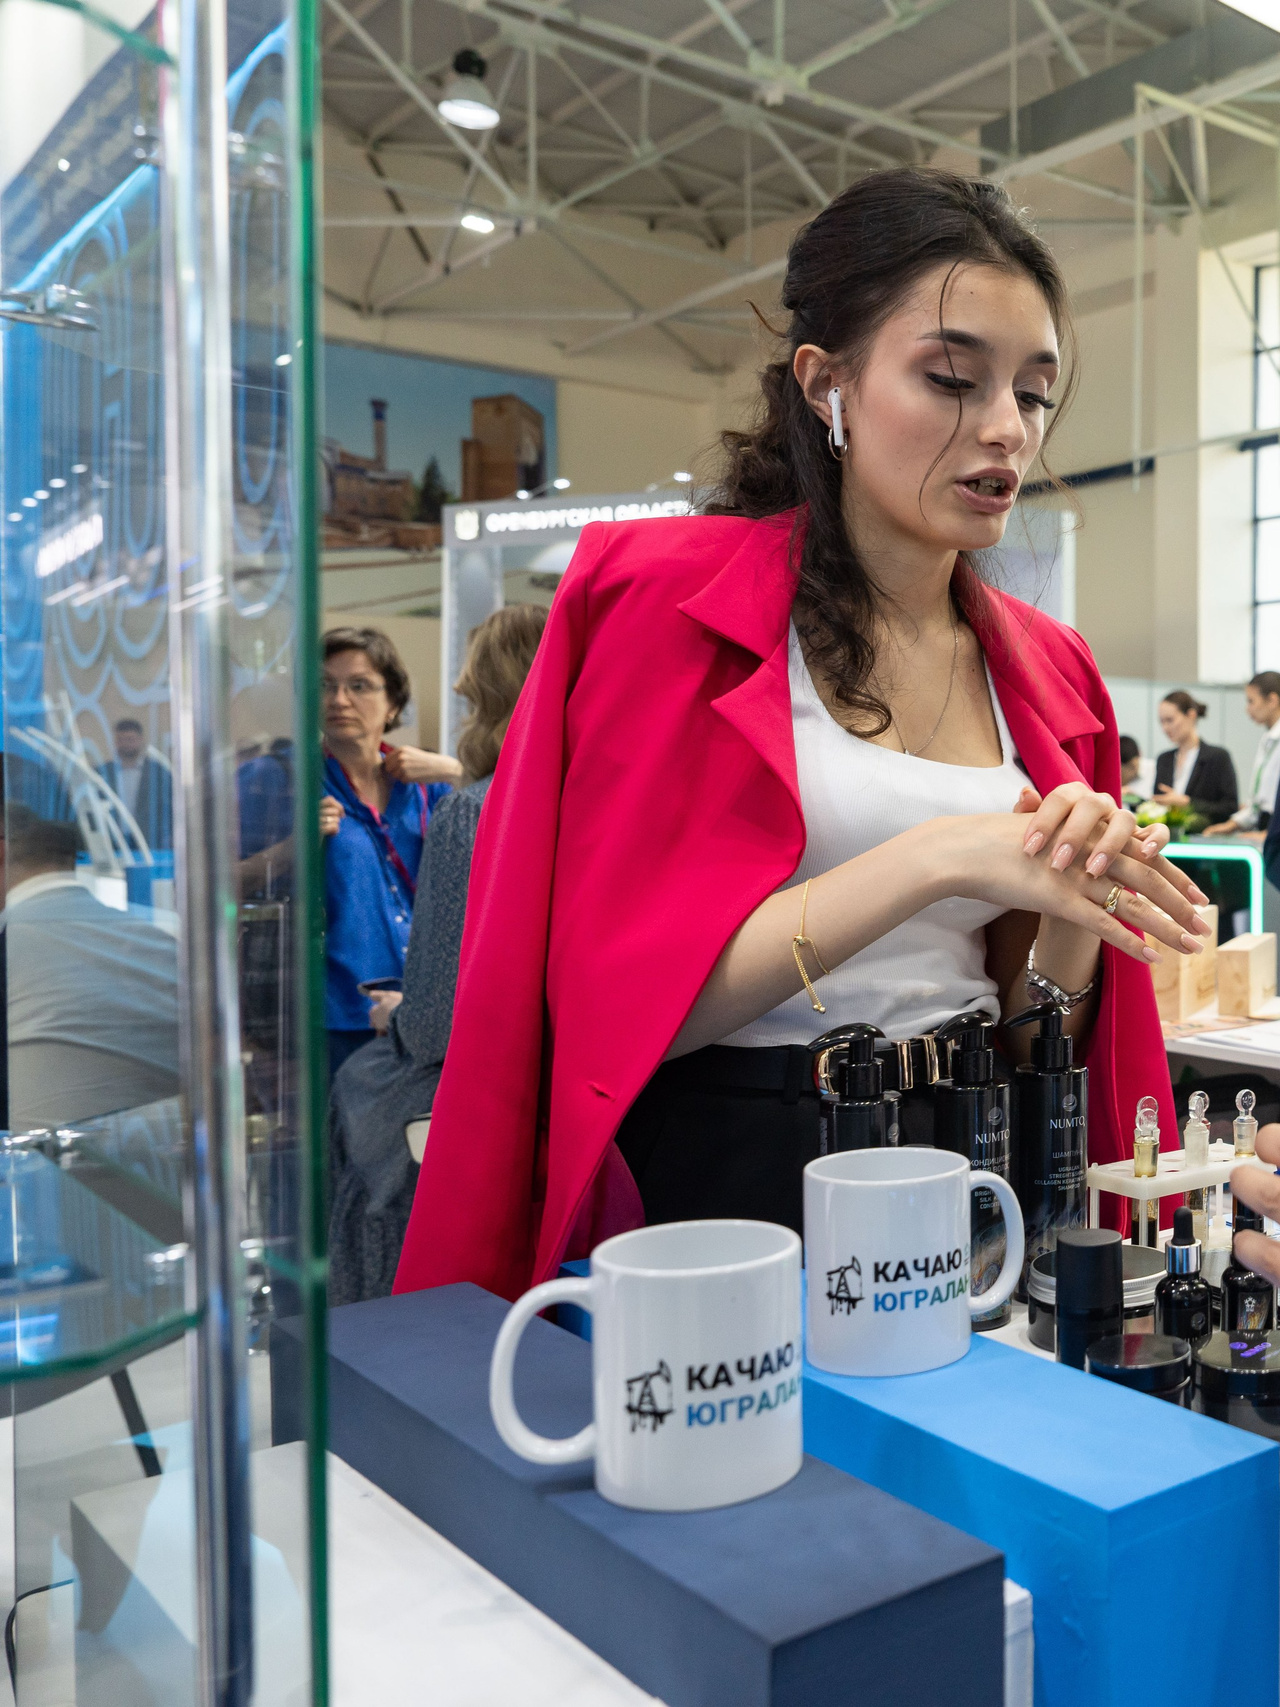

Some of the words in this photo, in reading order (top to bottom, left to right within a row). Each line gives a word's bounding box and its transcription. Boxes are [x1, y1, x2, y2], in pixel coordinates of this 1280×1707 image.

[975, 1128, 1010, 1145] NUMTO
[873, 1248, 962, 1284] КАЧАЮ
[687, 1341, 795, 1391] КАЧАЮ
